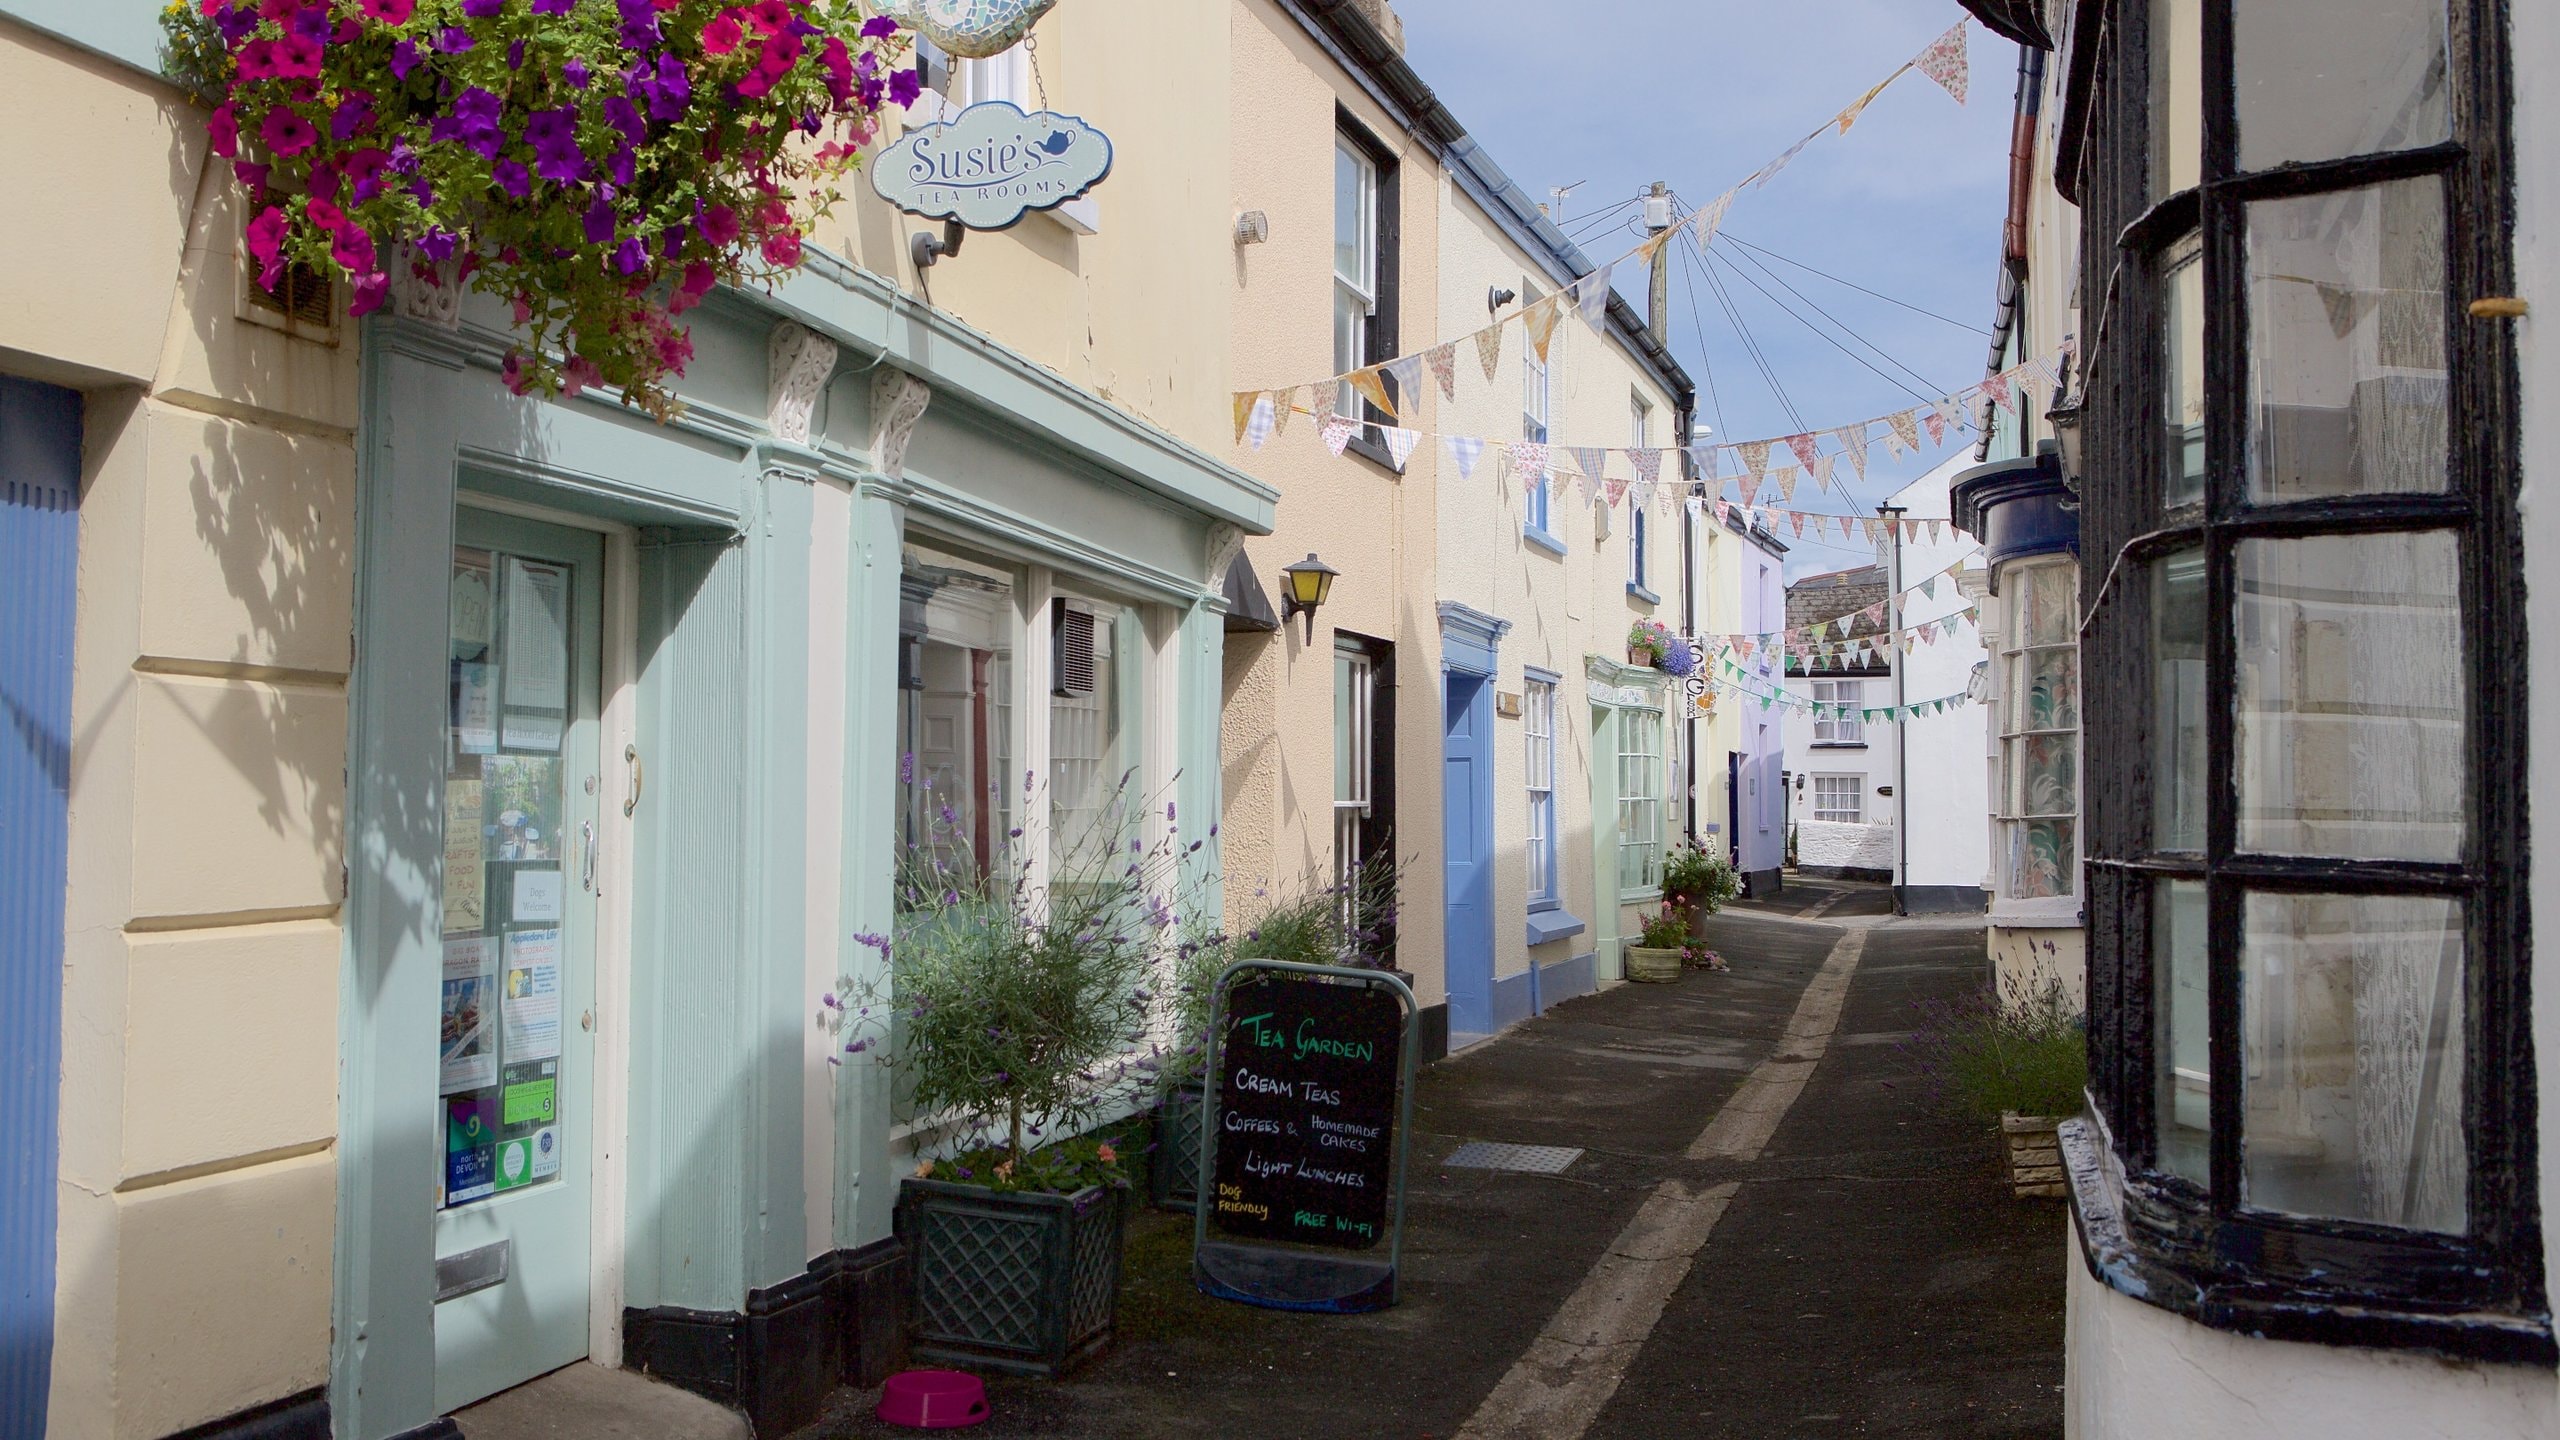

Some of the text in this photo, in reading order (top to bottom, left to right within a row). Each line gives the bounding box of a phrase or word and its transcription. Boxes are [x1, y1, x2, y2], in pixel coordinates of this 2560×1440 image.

[908, 134, 1042, 183] Susie's
[917, 179, 1066, 205] TEA ROOMS
[454, 591, 489, 639] OPEN
[448, 865, 474, 875] FOOD
[529, 887, 546, 900] Dogs
[522, 901, 552, 913] Welcome
[1241, 1012, 1373, 1061] TEA GARDEN
[1236, 1067, 1340, 1105] CREAM TEAS
[544, 1099, 550, 1111] 5
[1225, 1111, 1380, 1138] COFFEES & HOMEMADE
[1320, 1133, 1366, 1153] CAKES
[456, 1161, 479, 1175] DEVON
[535, 1163, 557, 1173] MEMBER
[1297, 1156, 1365, 1187] LUNCHES
[1219, 1183, 1242, 1200] DOG
[1218, 1200, 1268, 1221] FRIENDLY
[1294, 1209, 1373, 1237] FREE WI-FI
